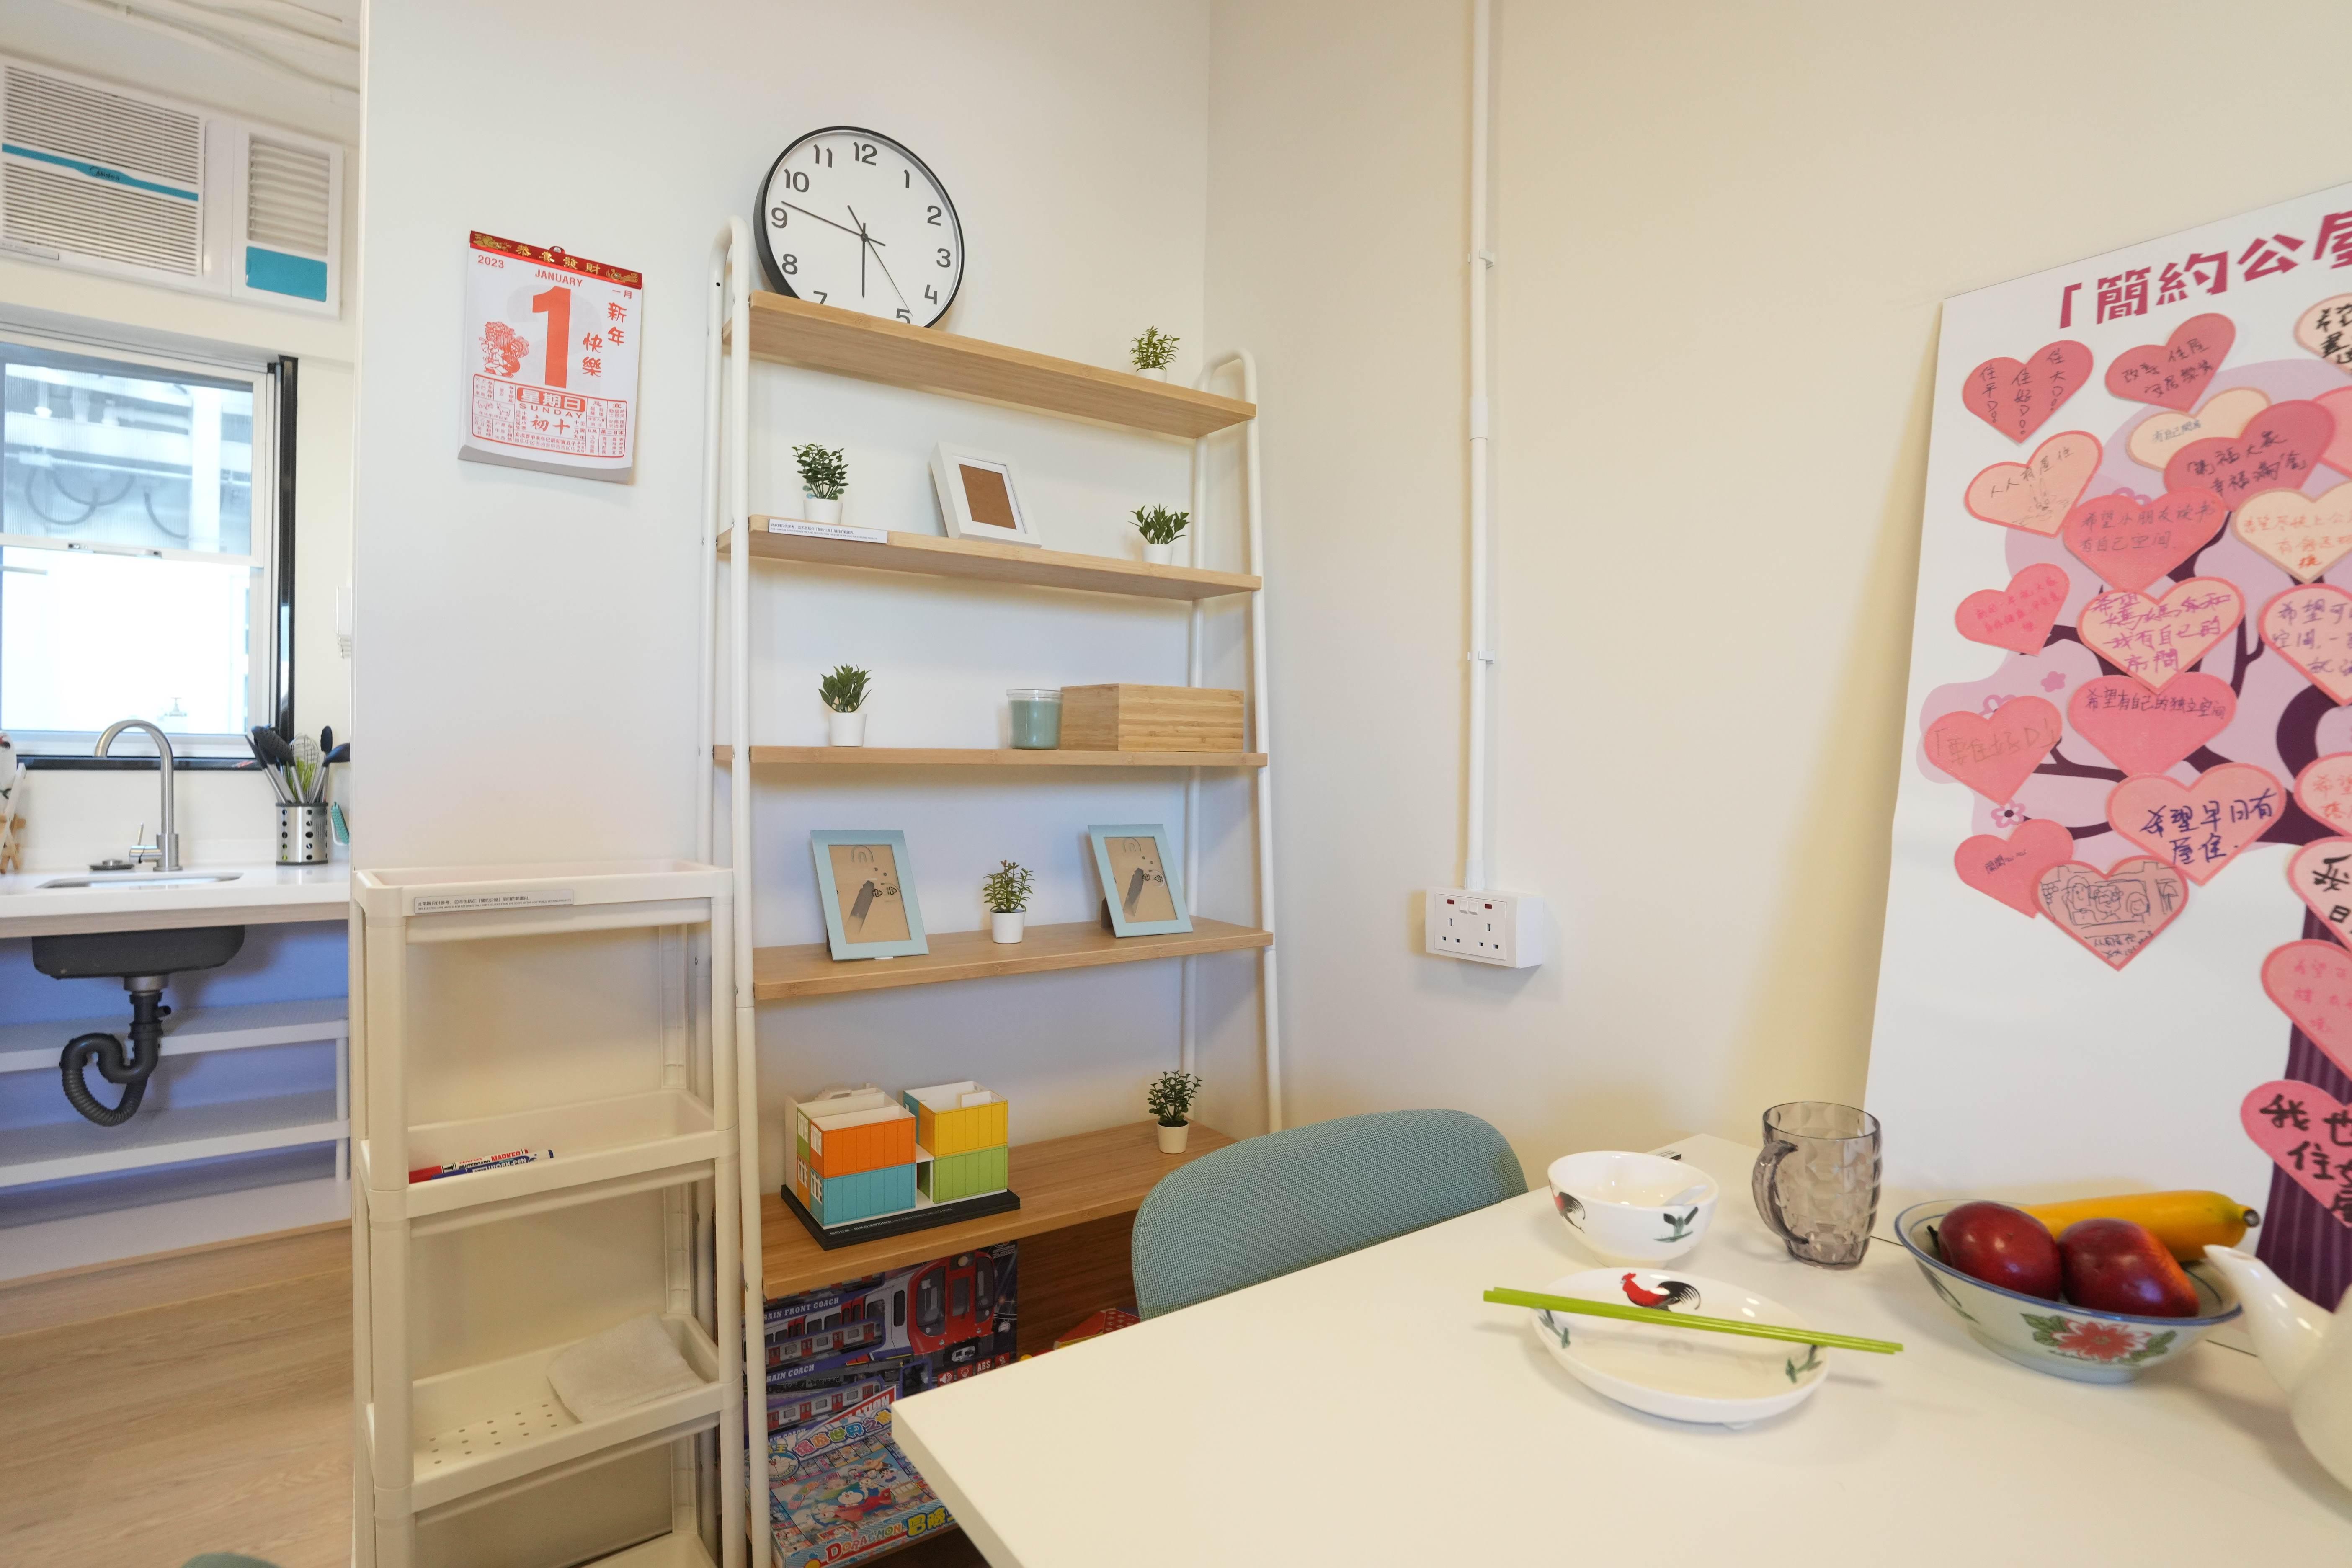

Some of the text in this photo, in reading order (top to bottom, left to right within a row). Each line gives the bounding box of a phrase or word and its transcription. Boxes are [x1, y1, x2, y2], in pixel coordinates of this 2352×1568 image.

[813, 144, 833, 168] 11
[853, 142, 877, 166] 12
[784, 168, 809, 192] 10
[904, 169, 910, 188] 1
[771, 207, 788, 228] 9
[927, 205, 942, 226] 2
[478, 255, 504, 268] 2023
[516, 244, 601, 275] 恭喜發財
[782, 254, 798, 275] 8
[936, 248, 951, 268] 3
[535, 269, 583, 287] JANUARY
[612, 289, 632, 299] 一月
[813, 291, 828, 304] 7
[924, 284, 937, 305] 4
[607, 302, 627, 346] 新年
[896, 308, 910, 324] 5
[532, 286, 571, 388] 1
[582, 332, 603, 377] 快樂
[521, 388, 581, 411] 星期日
[519, 403, 583, 419] SUNDAY
[531, 414, 570, 436] 初十
[2139, 788, 2277, 838] 希望早日有
[491, 1151, 521, 1162] MARKER
[764, 1297, 839, 1320] RAIN FRONT COACH
[766, 1364, 815, 1382] RAIN COACH
[977, 1360, 991, 1372] ABS
[908, 1507, 955, 1537] 冒險
[826, 1522, 903, 1563] DORAEMON
